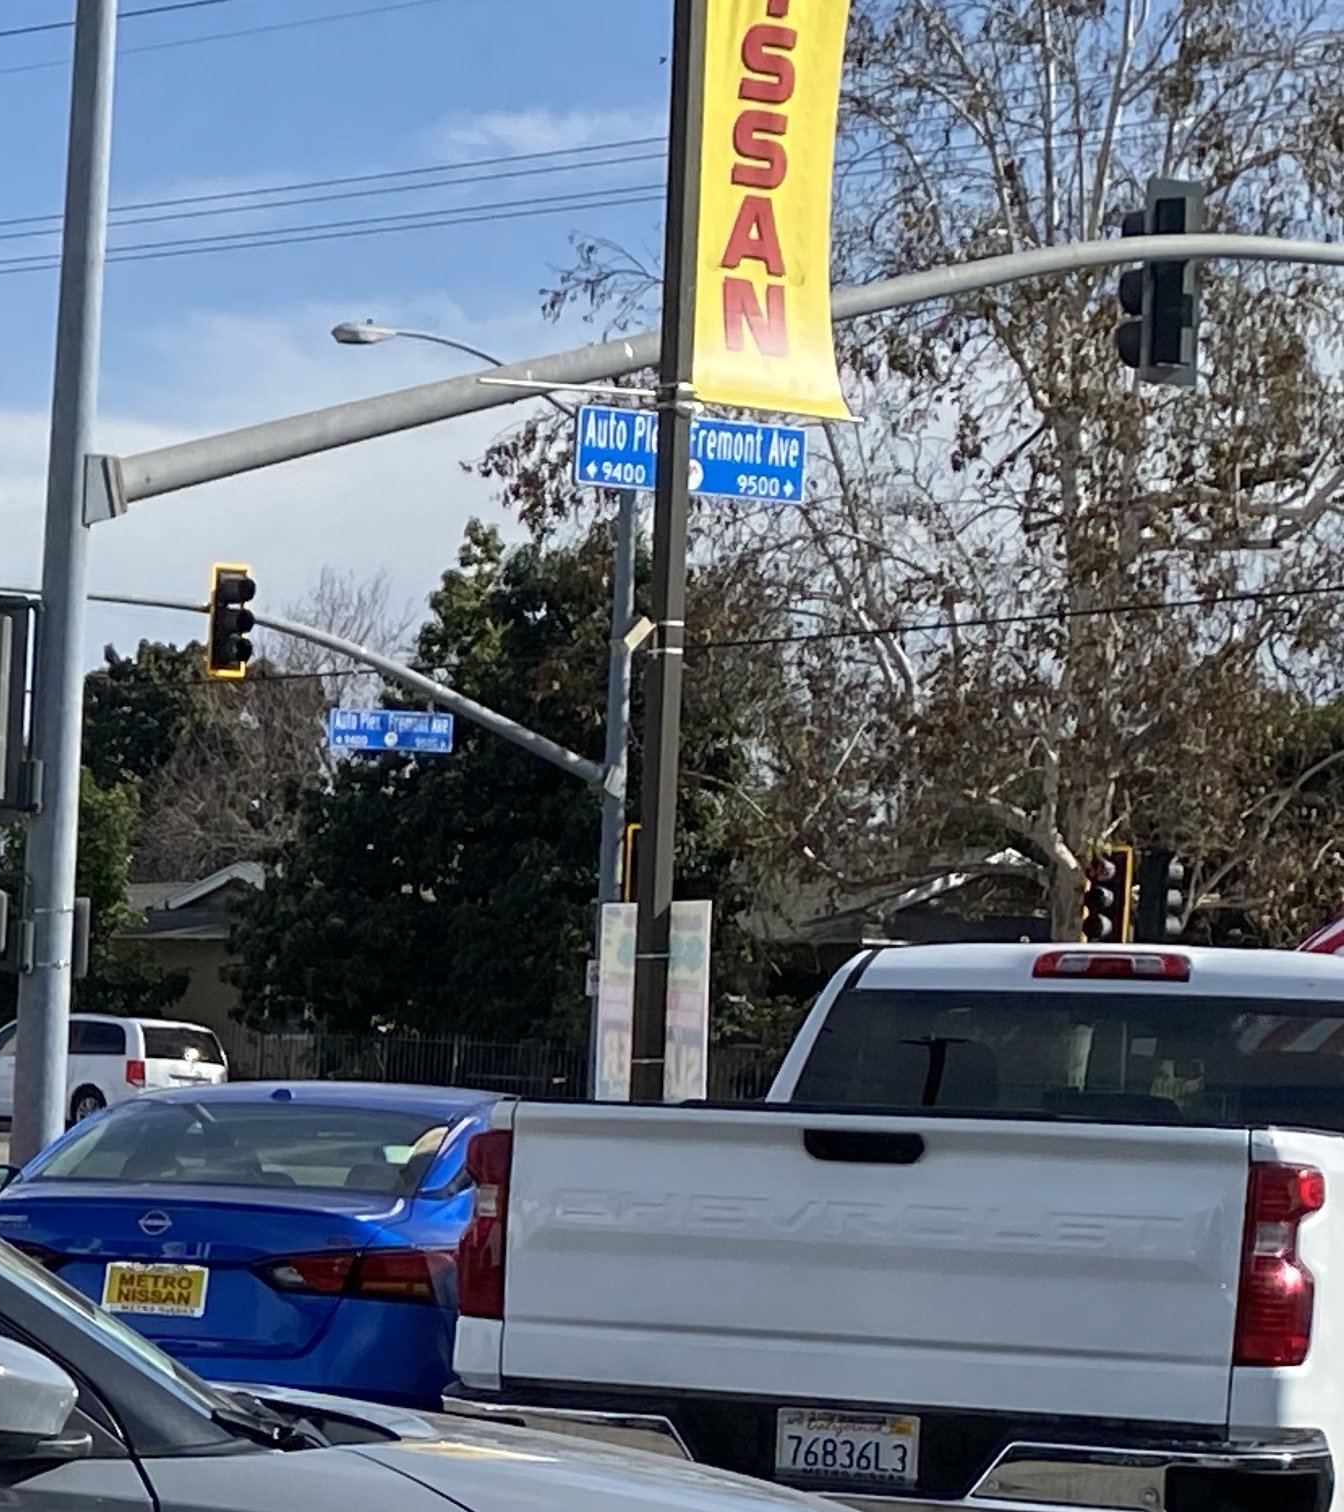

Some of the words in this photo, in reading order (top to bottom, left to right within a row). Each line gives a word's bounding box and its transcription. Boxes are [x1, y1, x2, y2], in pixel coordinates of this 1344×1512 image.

[720, 0, 798, 358] SSAN
[585, 411, 627, 451] Auto
[690, 423, 763, 465] Fremont
[768, 429, 800, 468] Ave
[601, 461, 646, 484] 9400
[737, 474, 780, 497] 9500
[554, 1187, 1188, 1249] CHEVROLET
[118, 1272, 194, 1290] METRO
[116, 1287, 192, 1306] NISSAN
[786, 1435, 908, 1473] 76836L3
